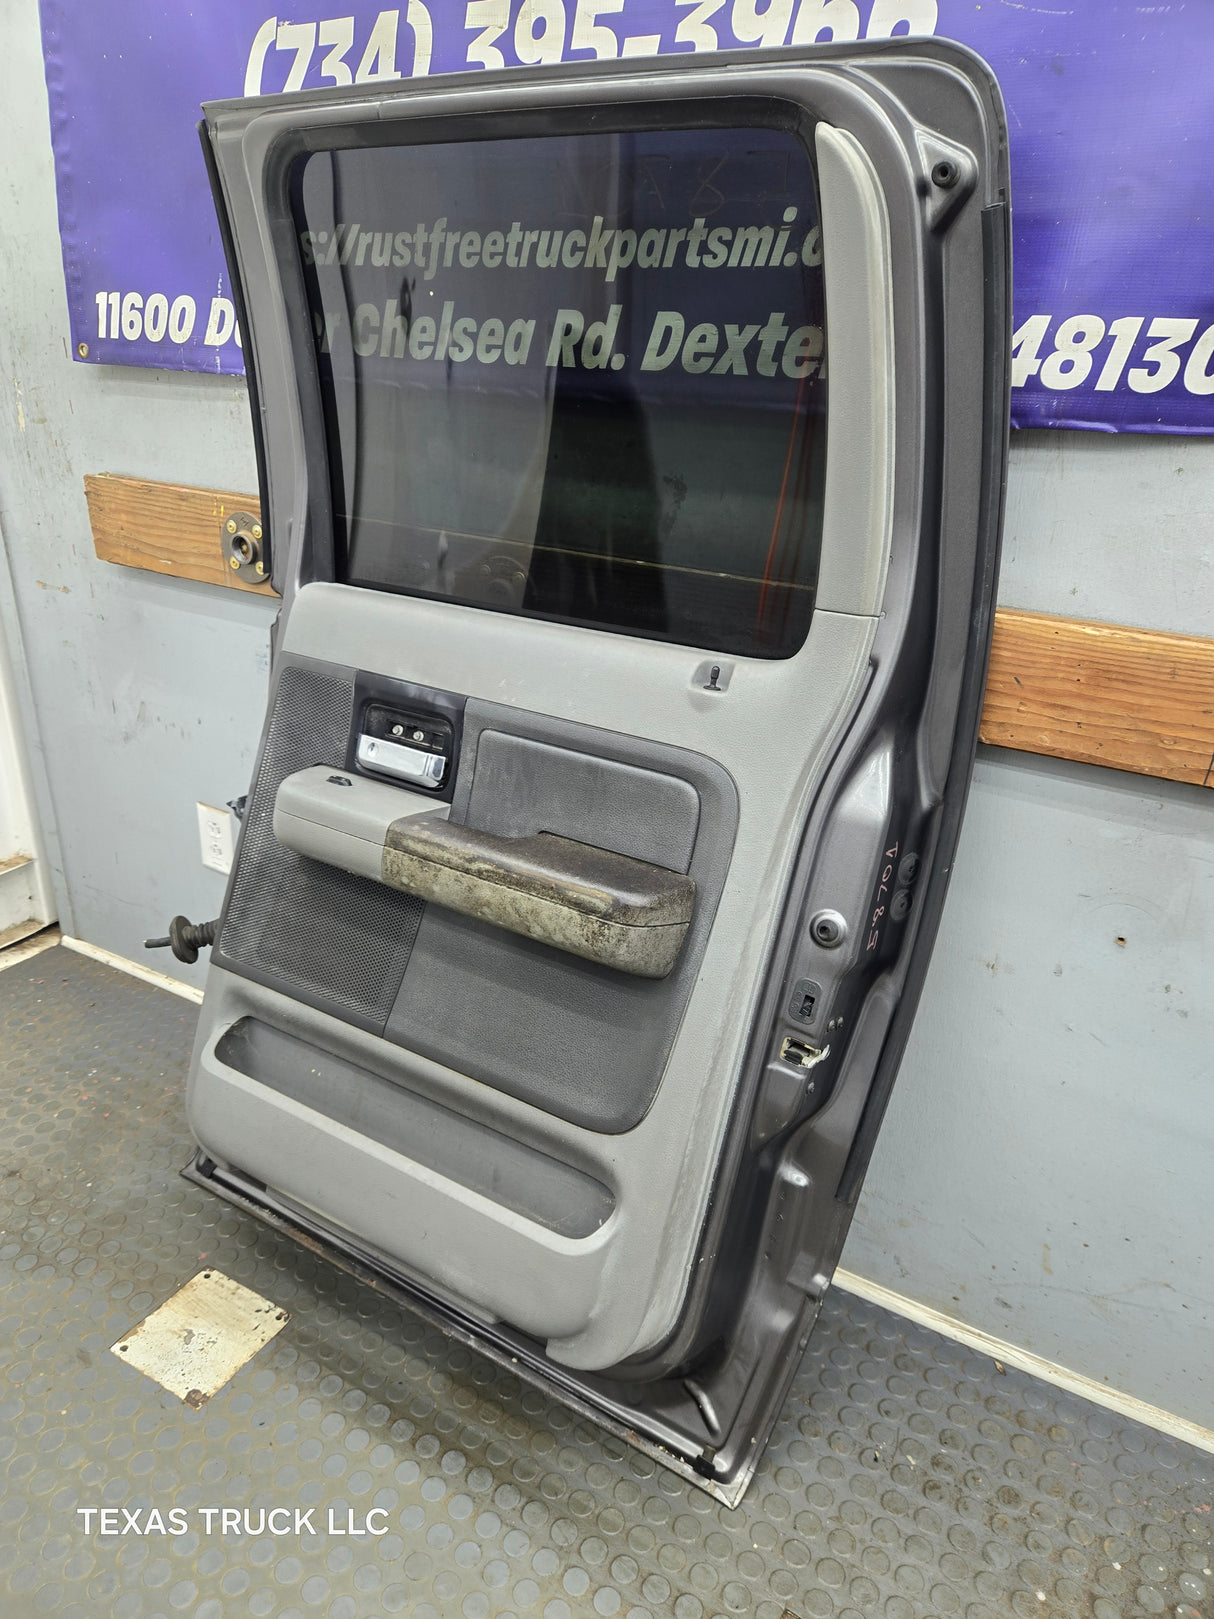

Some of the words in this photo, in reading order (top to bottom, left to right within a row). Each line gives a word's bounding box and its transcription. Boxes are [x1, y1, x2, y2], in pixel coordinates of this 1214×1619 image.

[244, 0, 433, 97] (734)
[95, 291, 197, 344] 11600
[203, 297, 243, 348] D
[352, 299, 536, 365] Chelsea
[545, 304, 626, 370] Rd.
[640, 311, 826, 379] Dexte
[1012, 314, 1214, 395] 48130
